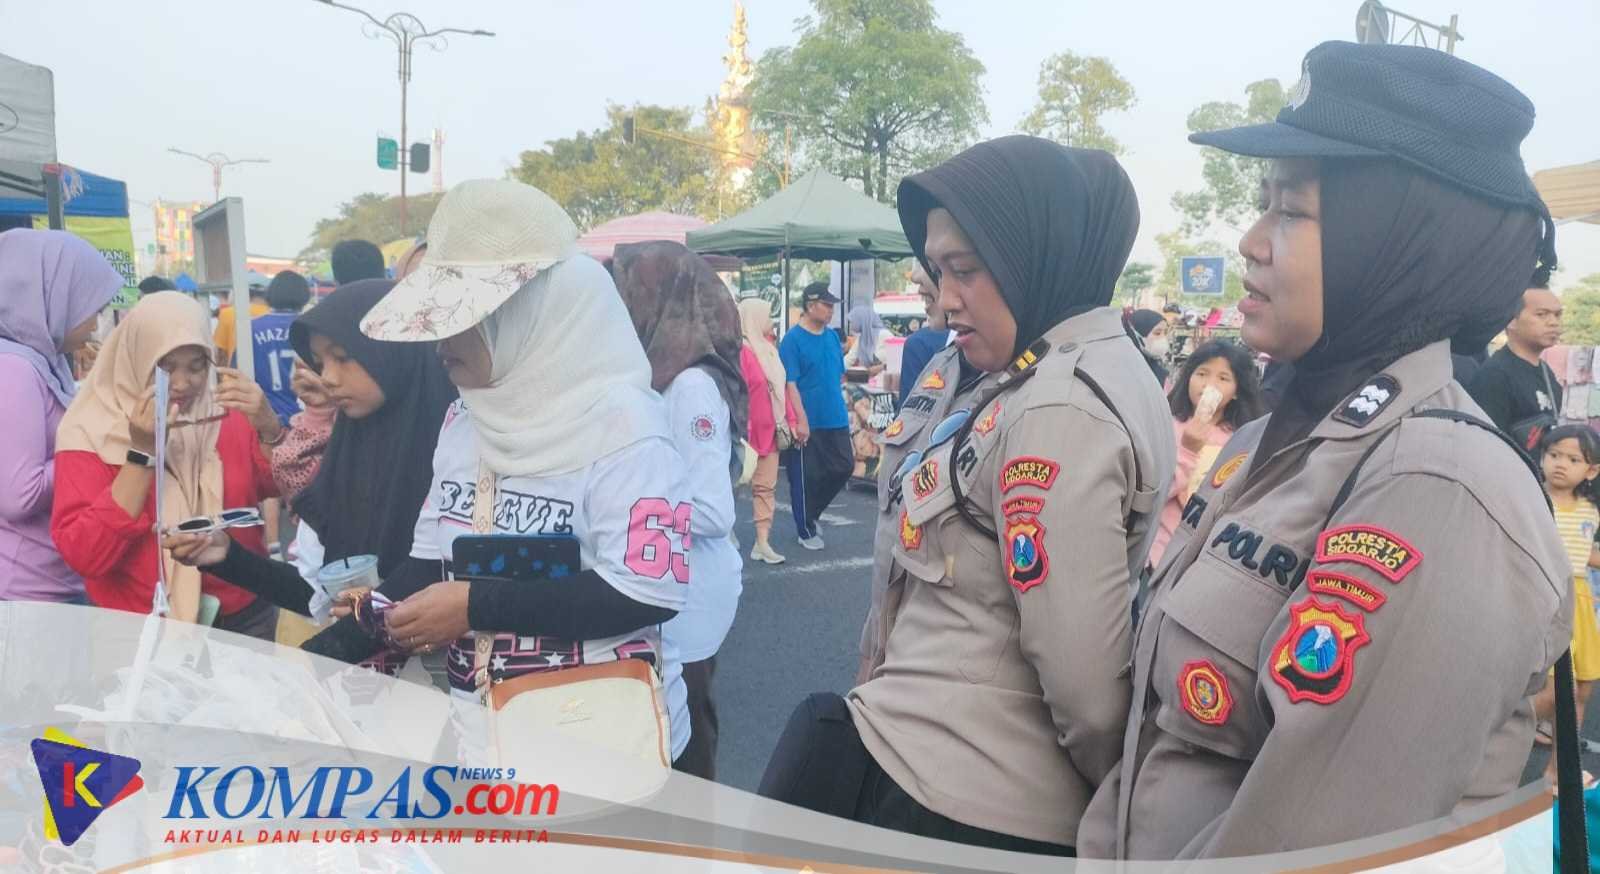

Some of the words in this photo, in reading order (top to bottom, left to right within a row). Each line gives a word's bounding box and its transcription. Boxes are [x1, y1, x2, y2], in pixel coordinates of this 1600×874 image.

[267, 349, 298, 391] 17
[1004, 461, 1050, 478] POLRESTA
[1212, 522, 1311, 591] POLRI
[1327, 531, 1407, 564] POLRESTA
[1327, 544, 1398, 570] SIDOARJO
[1318, 578, 1342, 590] JAWA
[1346, 583, 1376, 603] TIMUR
